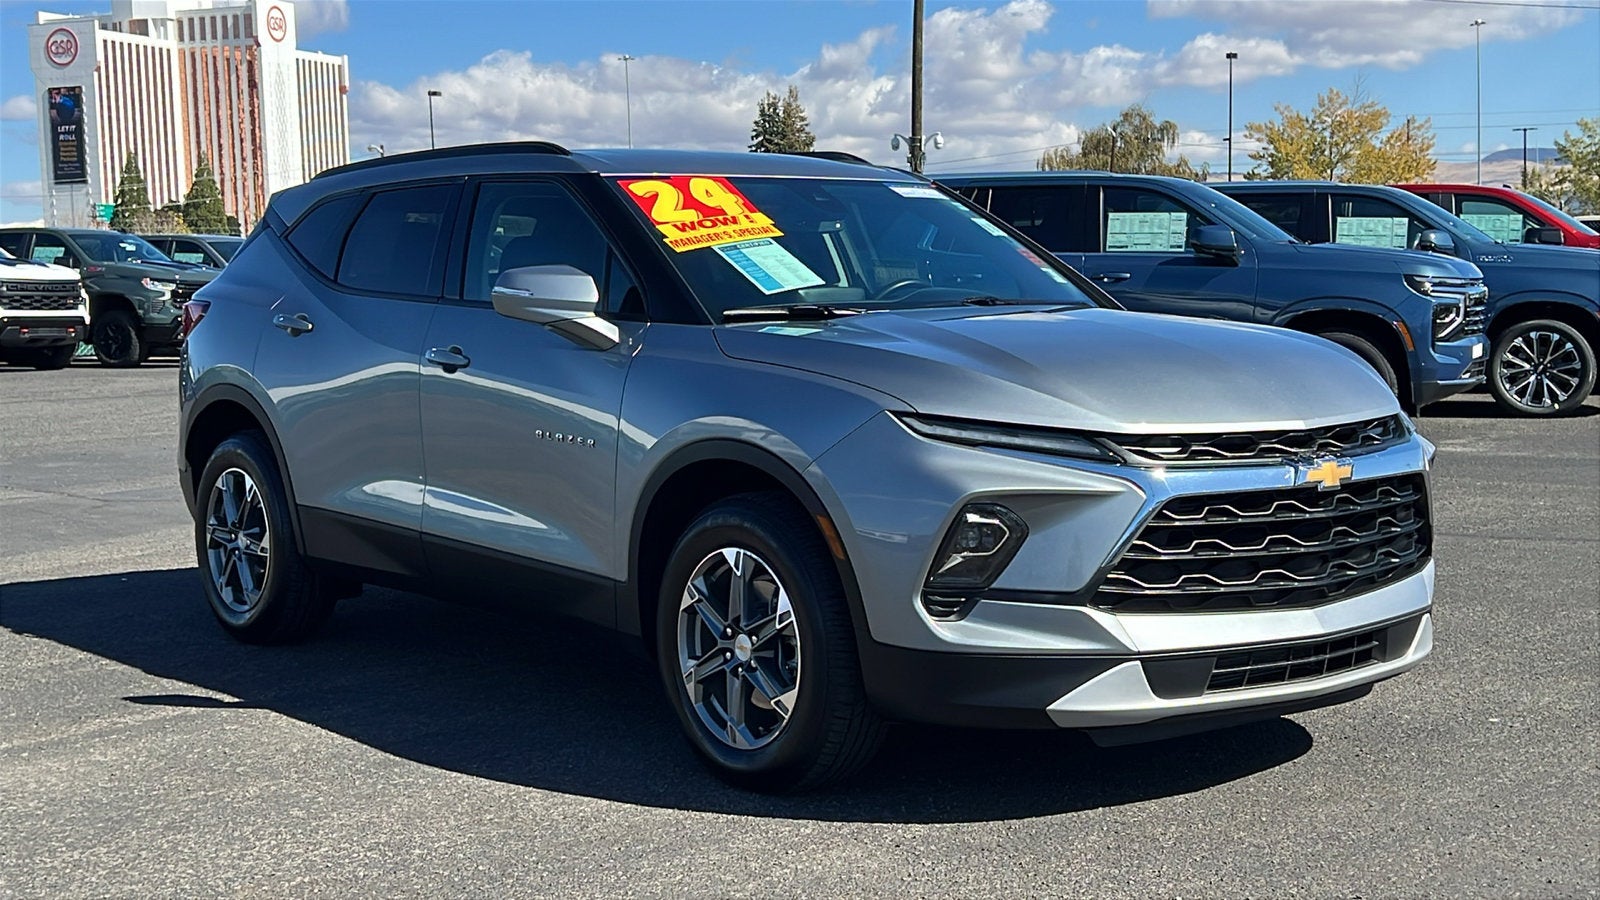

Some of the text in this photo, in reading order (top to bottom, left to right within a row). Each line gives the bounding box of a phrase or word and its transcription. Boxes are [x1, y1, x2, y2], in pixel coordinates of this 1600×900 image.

[270, 16, 285, 32] GSR
[50, 39, 74, 56] GSR
[628, 177, 747, 223] 24
[669, 225, 777, 248] MANAGER'S SPECIAL
[535, 429, 595, 448] BLAZER
